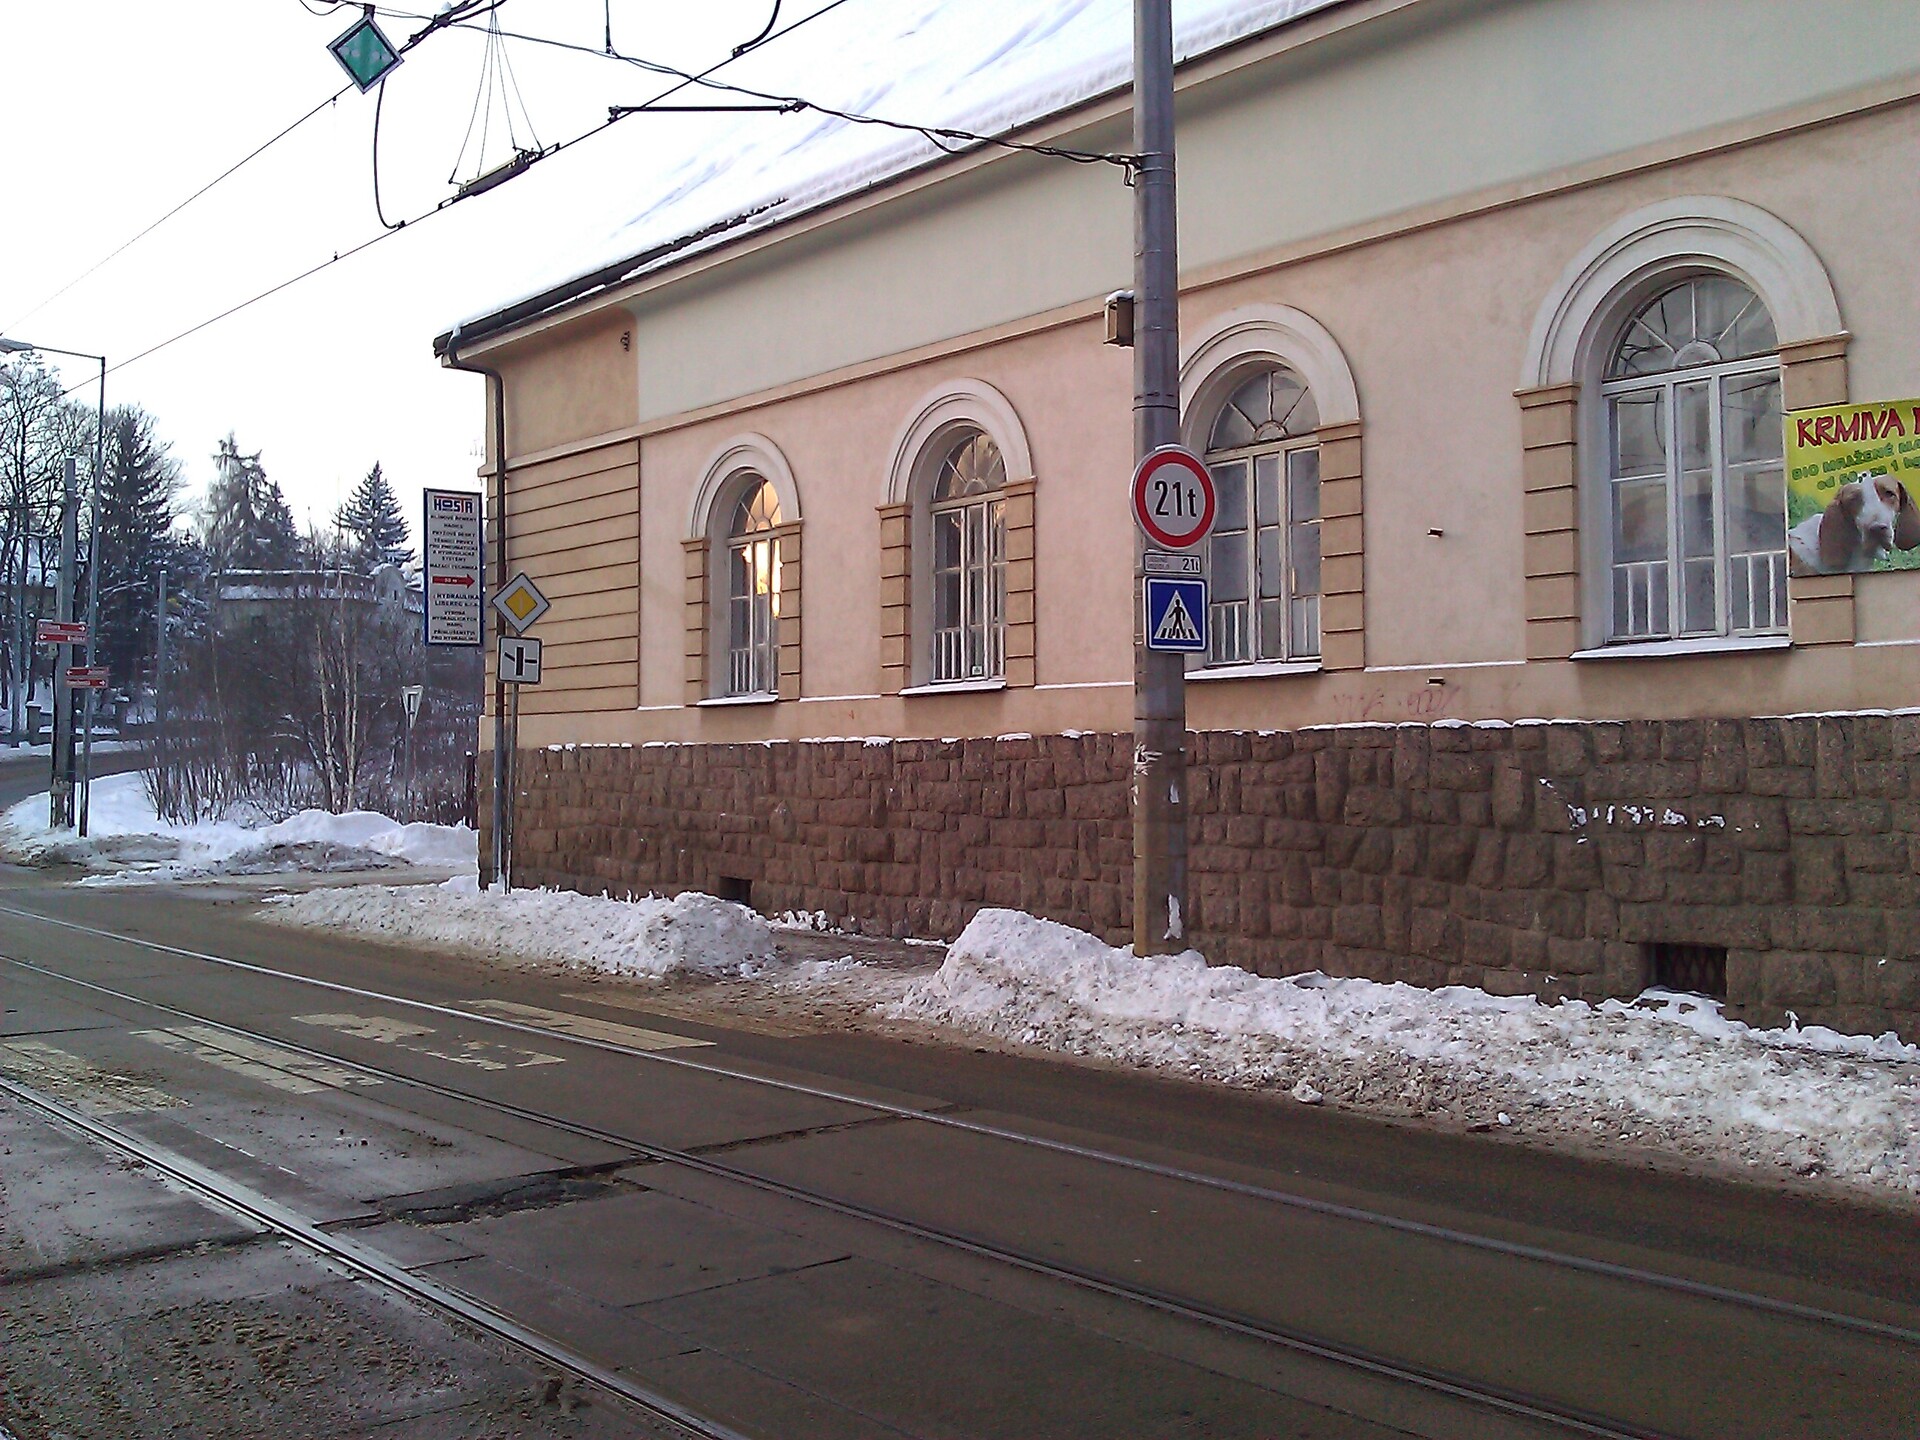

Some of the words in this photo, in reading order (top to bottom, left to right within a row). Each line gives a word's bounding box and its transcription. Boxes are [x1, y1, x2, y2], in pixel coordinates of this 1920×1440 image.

[1797, 407, 1906, 448] KRMIVA
[1791, 463, 1819, 481] BIO
[1822, 442, 1894, 474] MRAŽENÉ
[1816, 475, 1836, 491] od
[1890, 458, 1899, 472] 1
[433, 496, 473, 514] HOSTA
[1154, 480, 1198, 518] 21t
